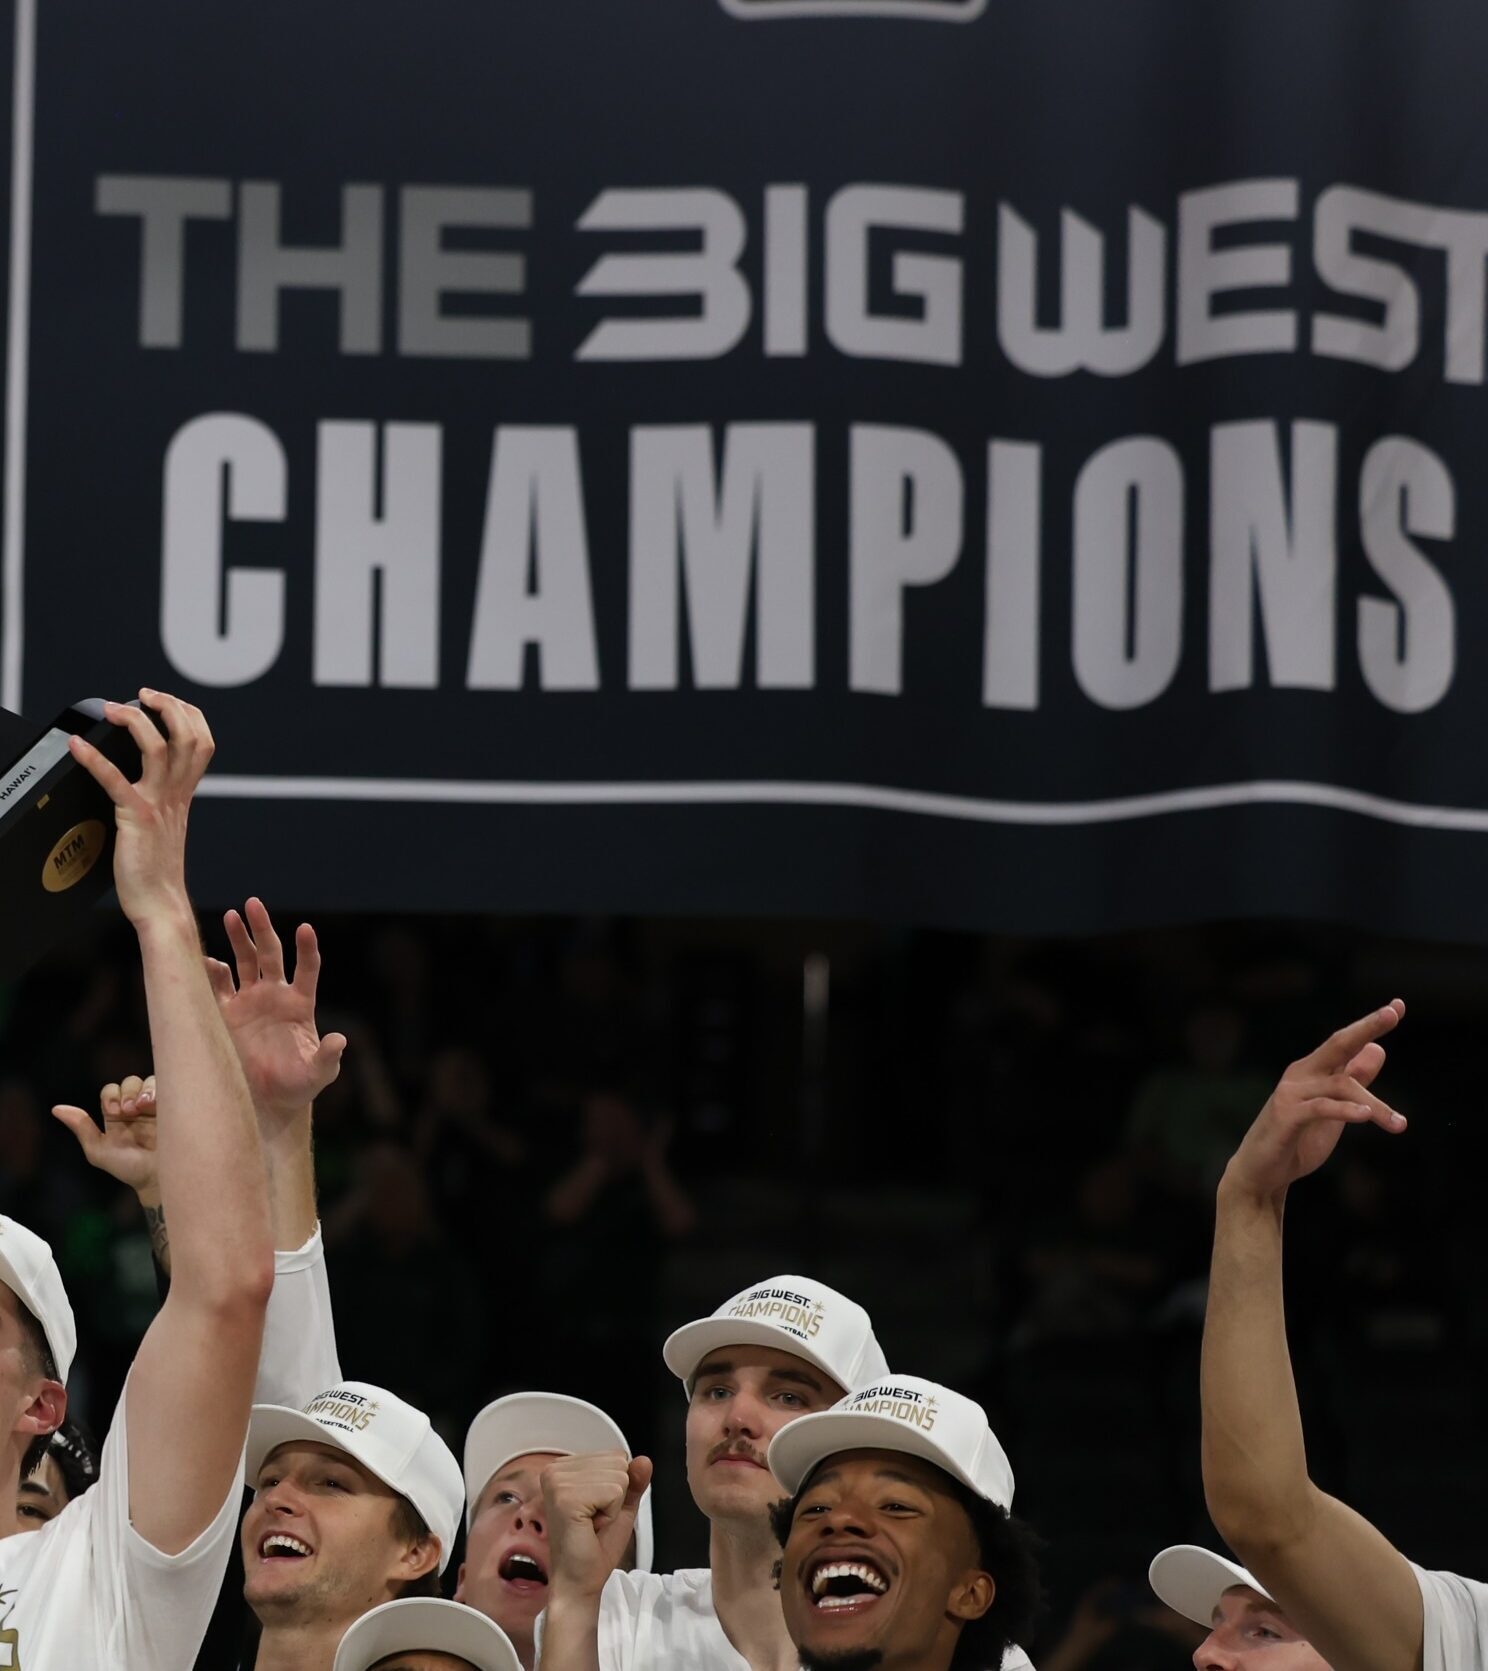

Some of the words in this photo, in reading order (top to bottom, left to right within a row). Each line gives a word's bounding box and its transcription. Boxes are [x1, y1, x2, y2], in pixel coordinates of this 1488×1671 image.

[97, 175, 532, 360] THE
[574, 184, 964, 366] BIG
[997, 178, 1488, 385] WEST
[159, 411, 1456, 714] CHAMPIONS
[53, 834, 85, 869] MTM
[748, 1289, 771, 1301] BIG
[853, 1387, 879, 1403] BIG
